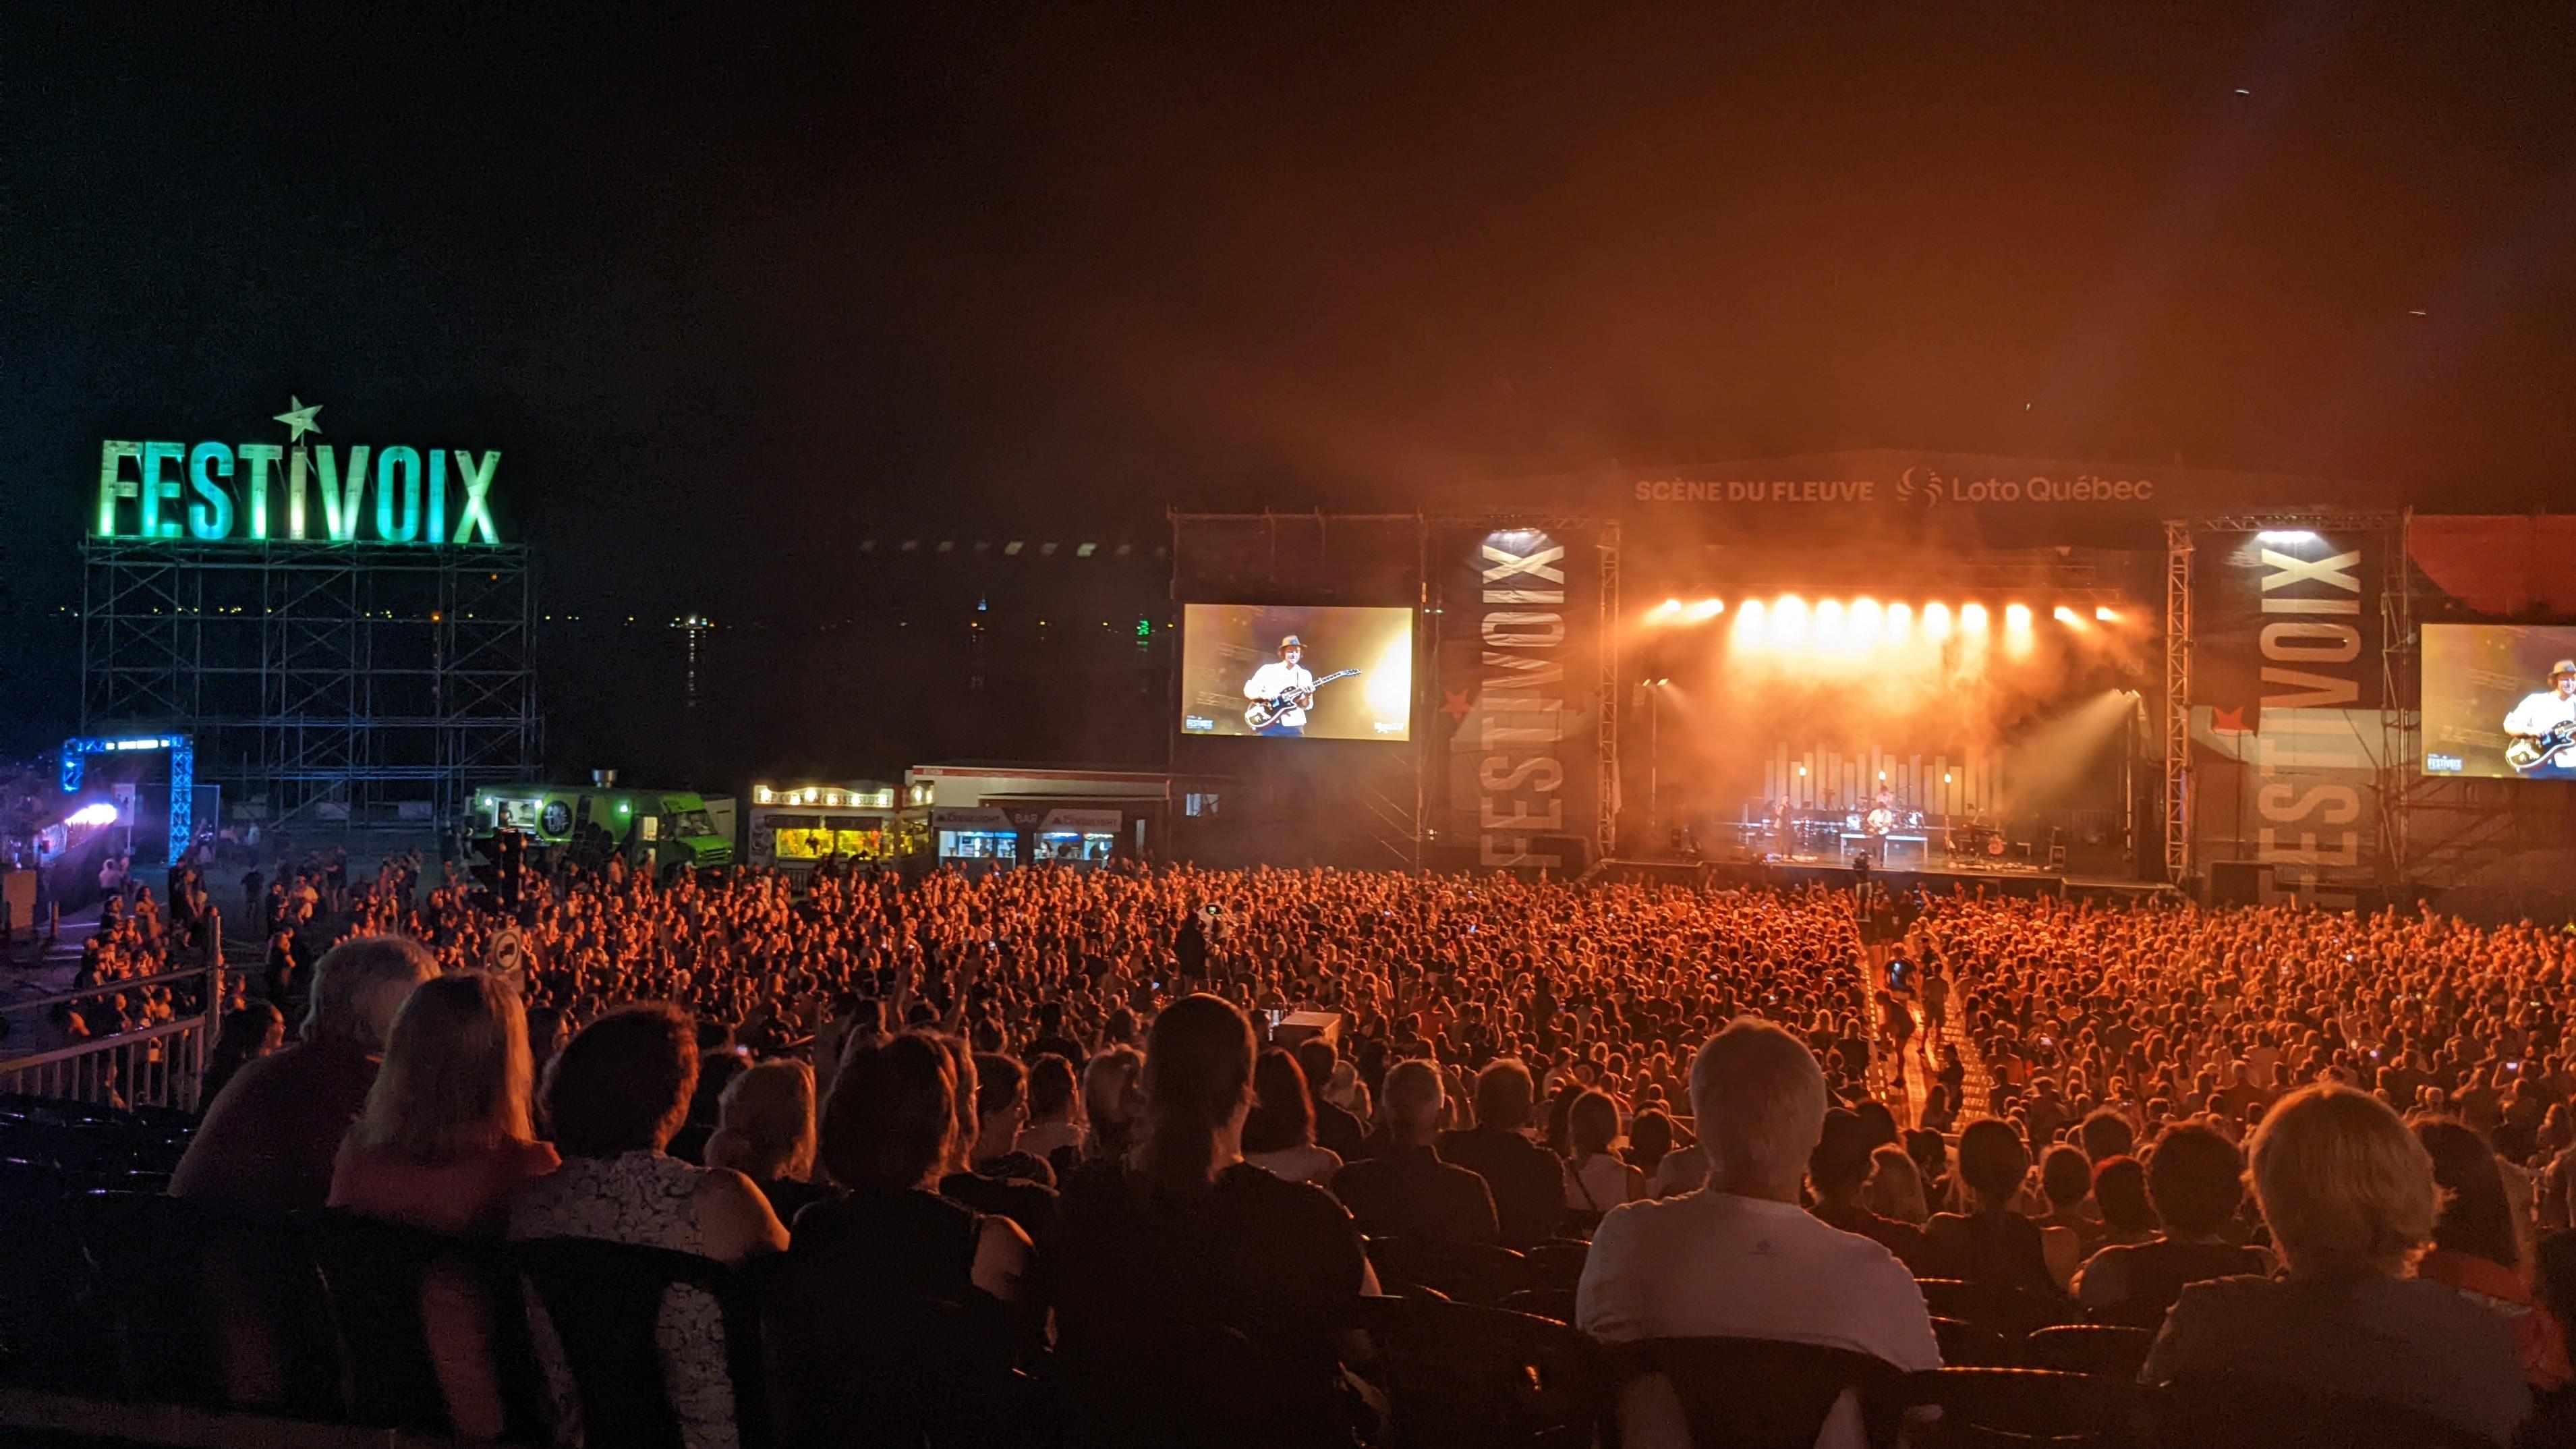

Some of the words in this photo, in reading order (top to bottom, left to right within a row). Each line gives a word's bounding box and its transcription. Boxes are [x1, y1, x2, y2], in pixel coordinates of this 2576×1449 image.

[98, 438, 502, 544] FESTIVOIX
[1635, 476, 1723, 502] SCÈNE
[1727, 481, 1766, 501] DU
[1771, 481, 1874, 502] FLEUVE
[1952, 477, 2021, 502] Loto
[2026, 475, 2154, 502] Québec
[1480, 544, 1565, 868] FESTIVOIX
[2258, 548, 2362, 907] FESTIVOIX
[1014, 814, 1038, 824] BAR
